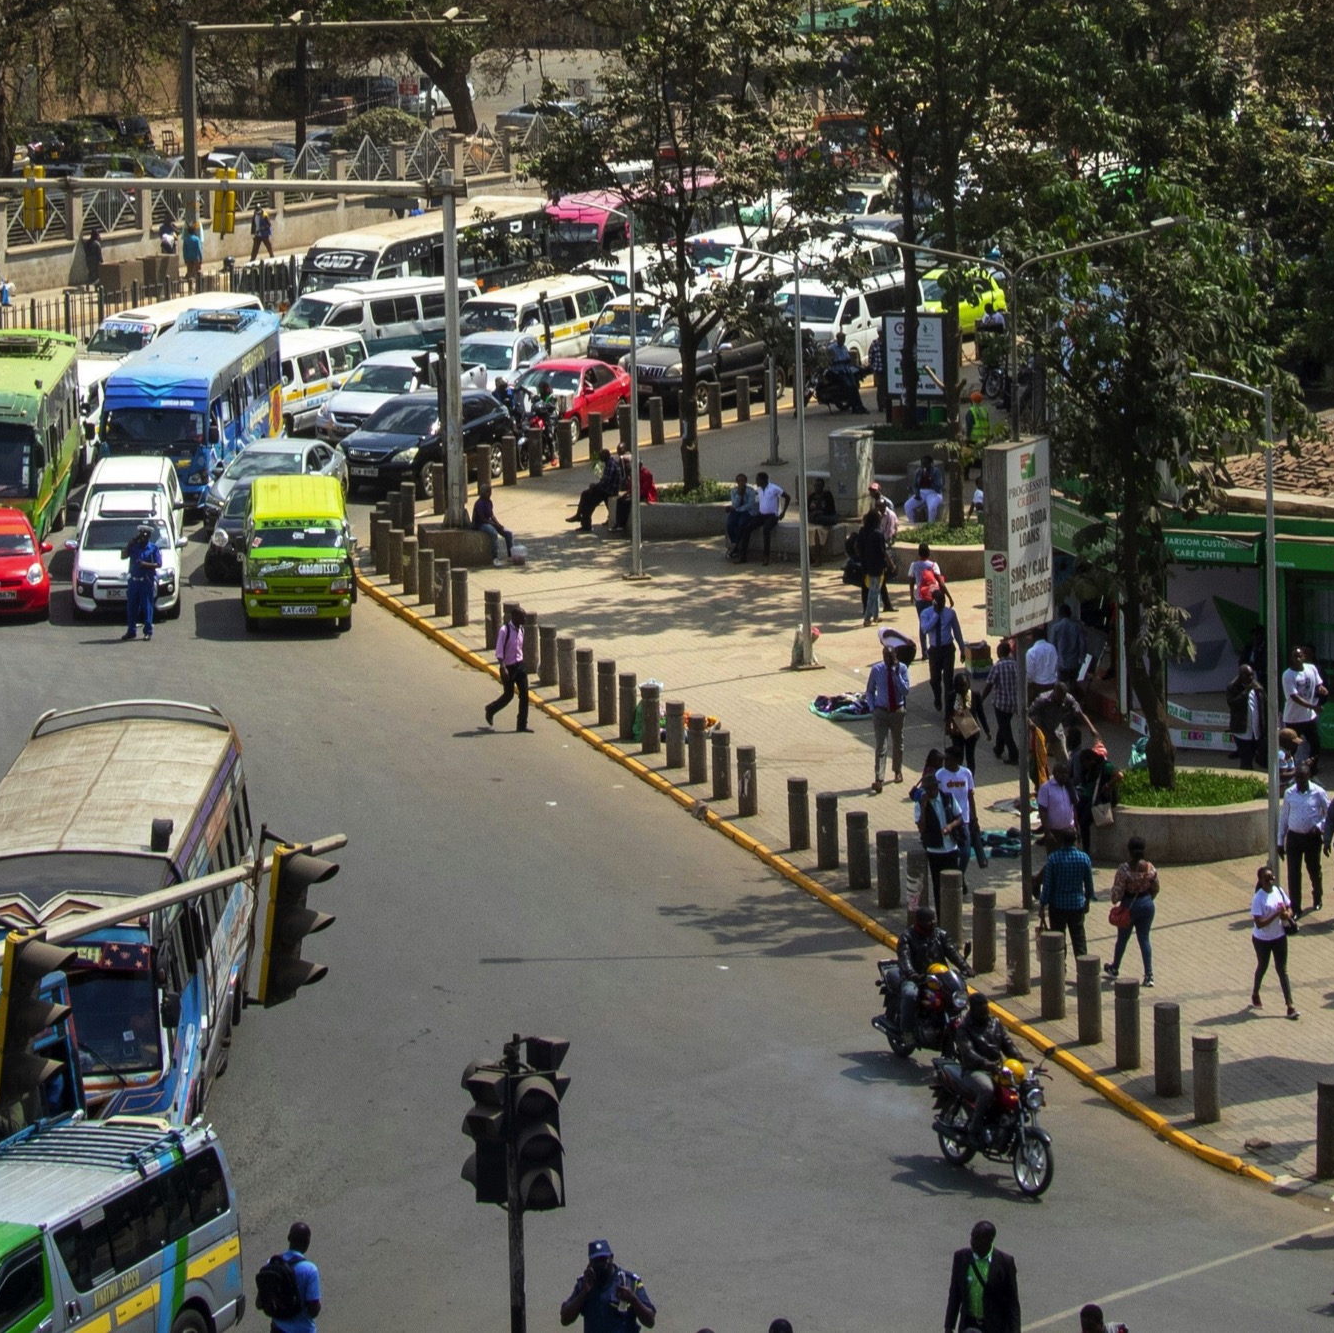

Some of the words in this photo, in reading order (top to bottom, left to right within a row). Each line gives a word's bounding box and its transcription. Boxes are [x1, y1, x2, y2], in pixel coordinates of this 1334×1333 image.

[317, 255, 354, 269] AND
[354, 257, 366, 270] 1
[1009, 476, 1049, 499] PROGRESSIVE
[1018, 492, 1040, 508] CREDIT
[1011, 514, 1029, 533] BODA
[1030, 508, 1047, 527] BODA
[1019, 528, 1040, 547] LOANS
[1164, 536, 1200, 547] FARICOM
[1174, 549, 1195, 558] CARE
[1197, 549, 1226, 560] CENTER
[1011, 564, 1027, 584] SMS
[1032, 556, 1049, 576] CALL
[121, 1268, 141, 1294] SACCO
